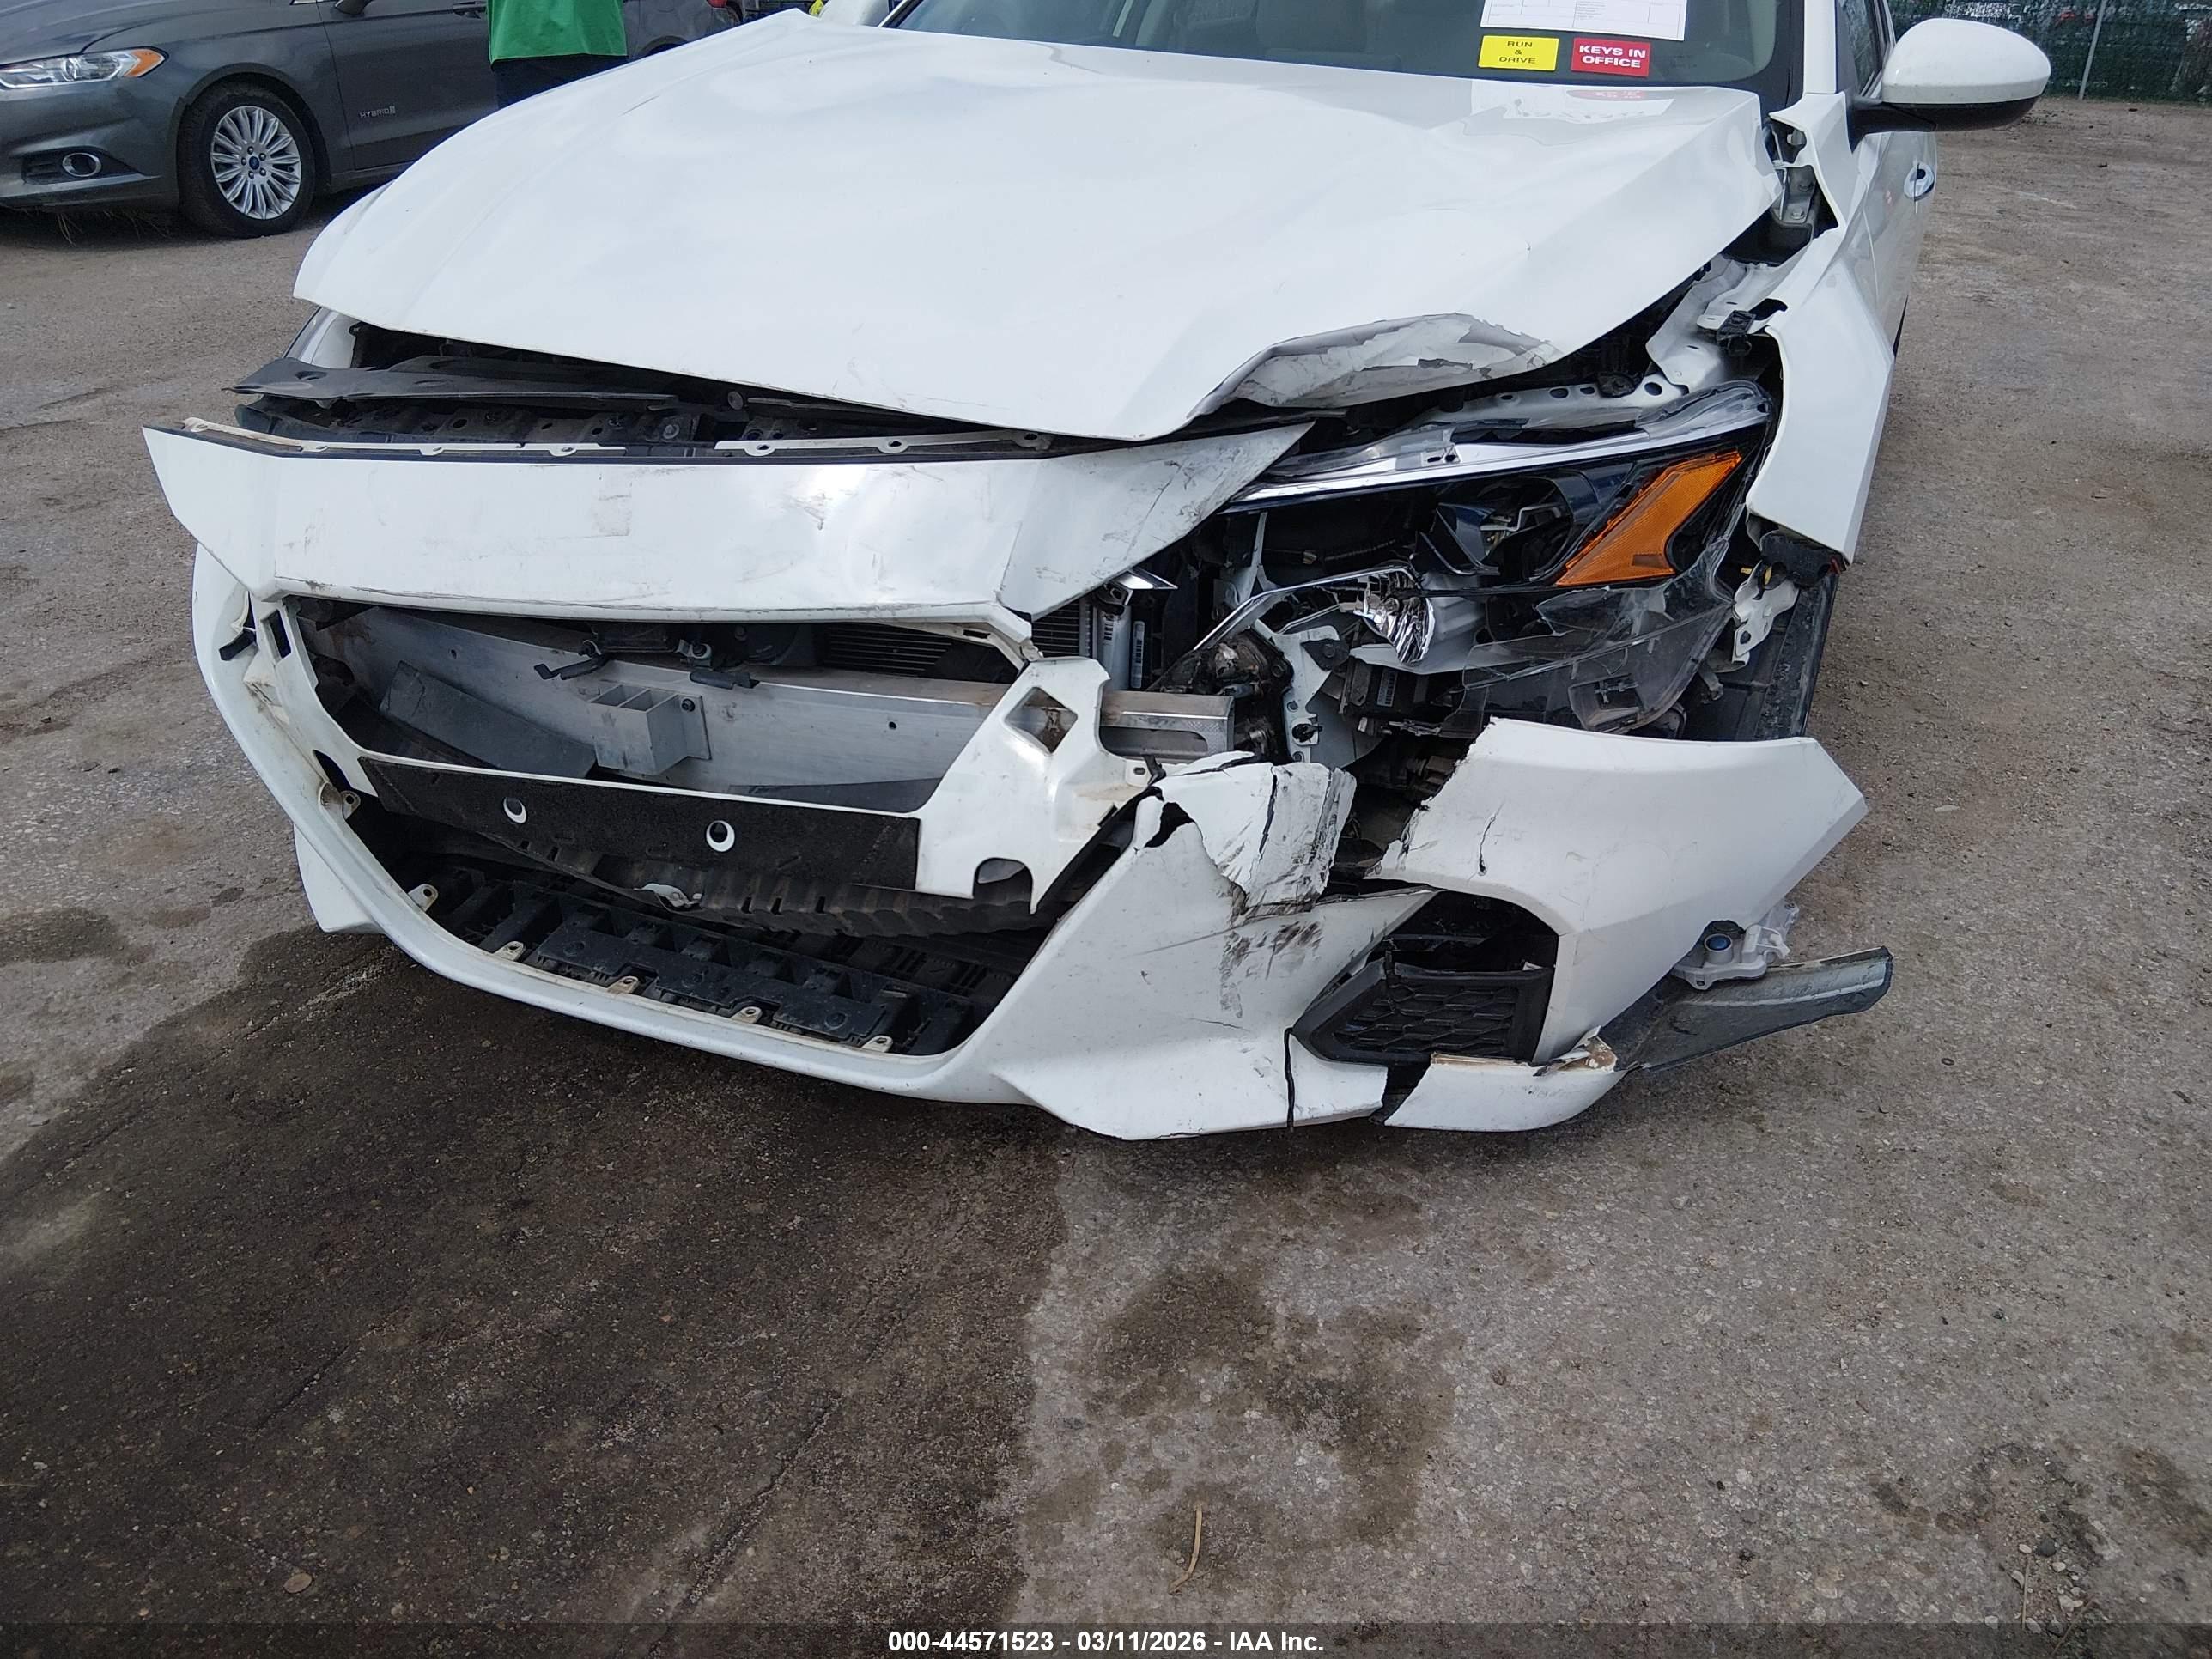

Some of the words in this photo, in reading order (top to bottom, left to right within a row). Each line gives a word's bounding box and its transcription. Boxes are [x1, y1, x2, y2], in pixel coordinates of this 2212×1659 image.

[1579, 45, 1623, 56] KEYS
[1628, 48, 1646, 58] IN
[1498, 56, 1536, 64] DRIVE
[1582, 56, 1641, 68] OFFICE
